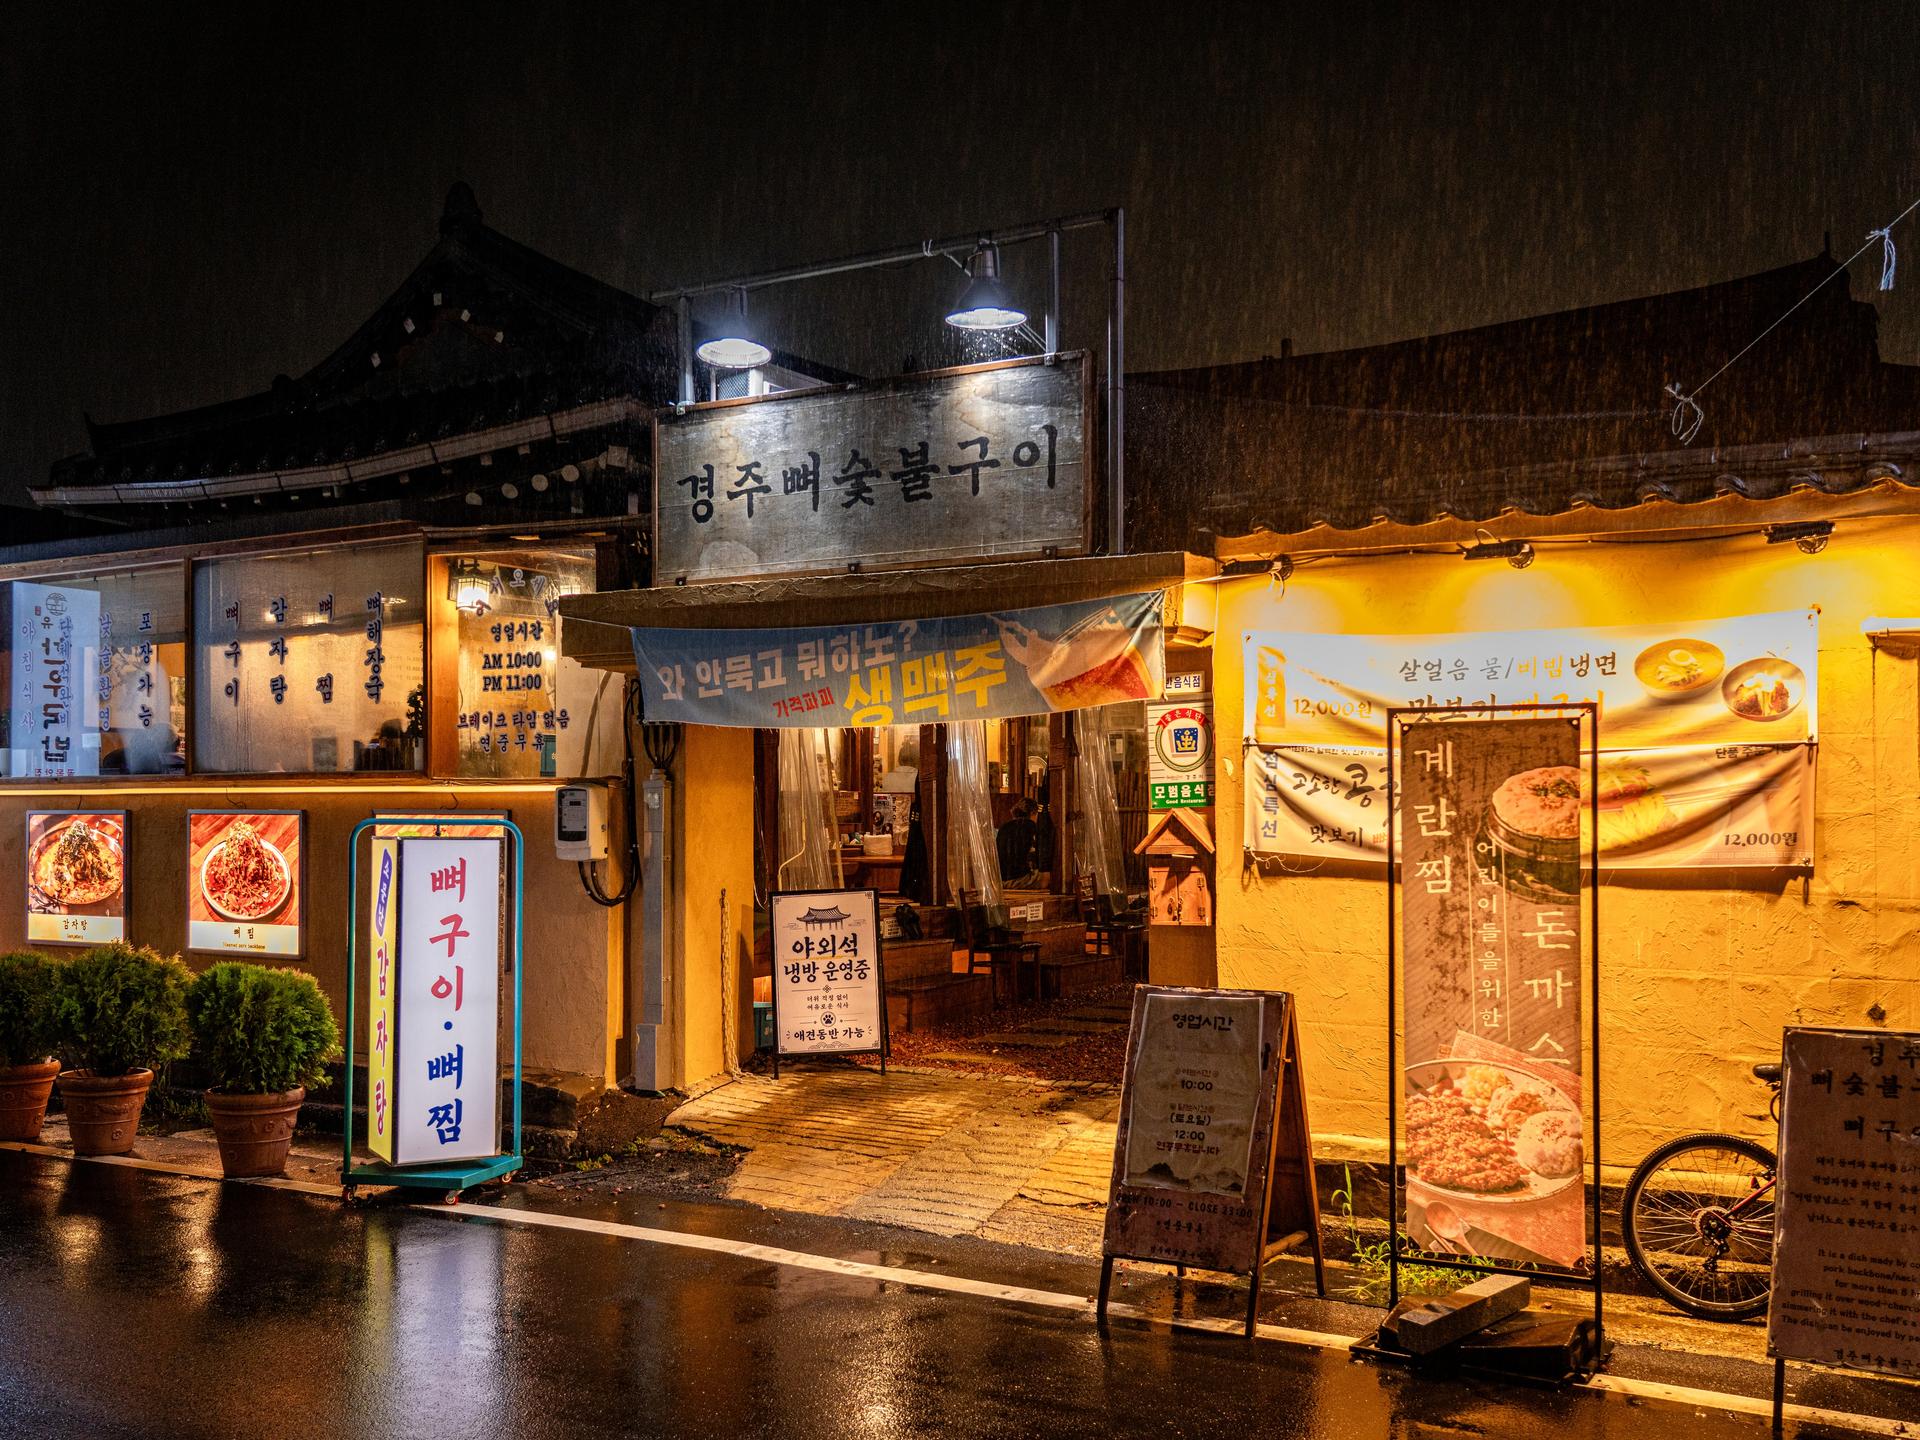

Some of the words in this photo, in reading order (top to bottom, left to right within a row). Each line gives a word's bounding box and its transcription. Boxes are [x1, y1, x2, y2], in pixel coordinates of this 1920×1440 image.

[677, 424, 1058, 524] 경주뼈숯불구이
[490, 621, 543, 643] 영업시간
[225, 601, 240, 706] 뼈구이
[269, 595, 288, 705] 감자탕
[365, 591, 384, 704] 뼈해장국
[482, 653, 503, 670] AM
[506, 652, 542, 669] 10:00
[659, 664, 685, 700] 와
[695, 647, 787, 700] 안묵고
[796, 619, 918, 682] 뭐하노?
[1399, 658, 1471, 682] 살얼음
[483, 676, 504, 692] PM
[506, 674, 542, 690] 11:00
[843, 639, 1007, 727] 생맥주
[772, 686, 835, 719] 가격파괴
[1293, 699, 1373, 718] 12,000원
[457, 711, 508, 731] 브레이크
[512, 709, 537, 730] 타임
[543, 708, 570, 730] 없음
[1154, 783, 1215, 799] 모범음식점
[1261, 752, 1279, 839] 점심특선
[1414, 740, 1457, 894] 계란찜
[1310, 825, 1363, 848] 맛보기
[62, 918, 88, 931] 감자탕
[792, 933, 859, 959] 야외석
[784, 961, 820, 984] 냉방
[822, 959, 871, 982] 운영중
[1522, 911, 1576, 1065] 돈까스
[794, 1027, 840, 1041] 애견동반
[842, 1026, 865, 1039] 가능
[1172, 1013, 1235, 1032] 영업시간
[375, 941, 389, 1135] 감자탕
[1180, 1080, 1214, 1091] 10:00
[1169, 1112, 1212, 1126] (토요일)
[1175, 1130, 1206, 1141] 12:00
[1187, 1201, 1218, 1214] CLOSE
[1823, 1265, 1844, 1273] pork
[1848, 1254, 1867, 1262] dish
[1896, 1257, 1907, 1268] by
[1790, 1290, 1822, 1300] grilling
[1825, 1292, 1832, 1300] it
[1834, 1279, 1848, 1287] for
[1851, 1283, 1874, 1292] more
[1877, 1285, 1898, 1295] than
[1840, 1310, 1858, 1319] with
[1862, 1312, 1877, 1322] the
[1782, 1315, 1798, 1324] The
[1800, 1317, 1818, 1328] dish
[1841, 1324, 1852, 1332] be
[1855, 1326, 1891, 1341] enjoyed
[1895, 1330, 1906, 1341] by
